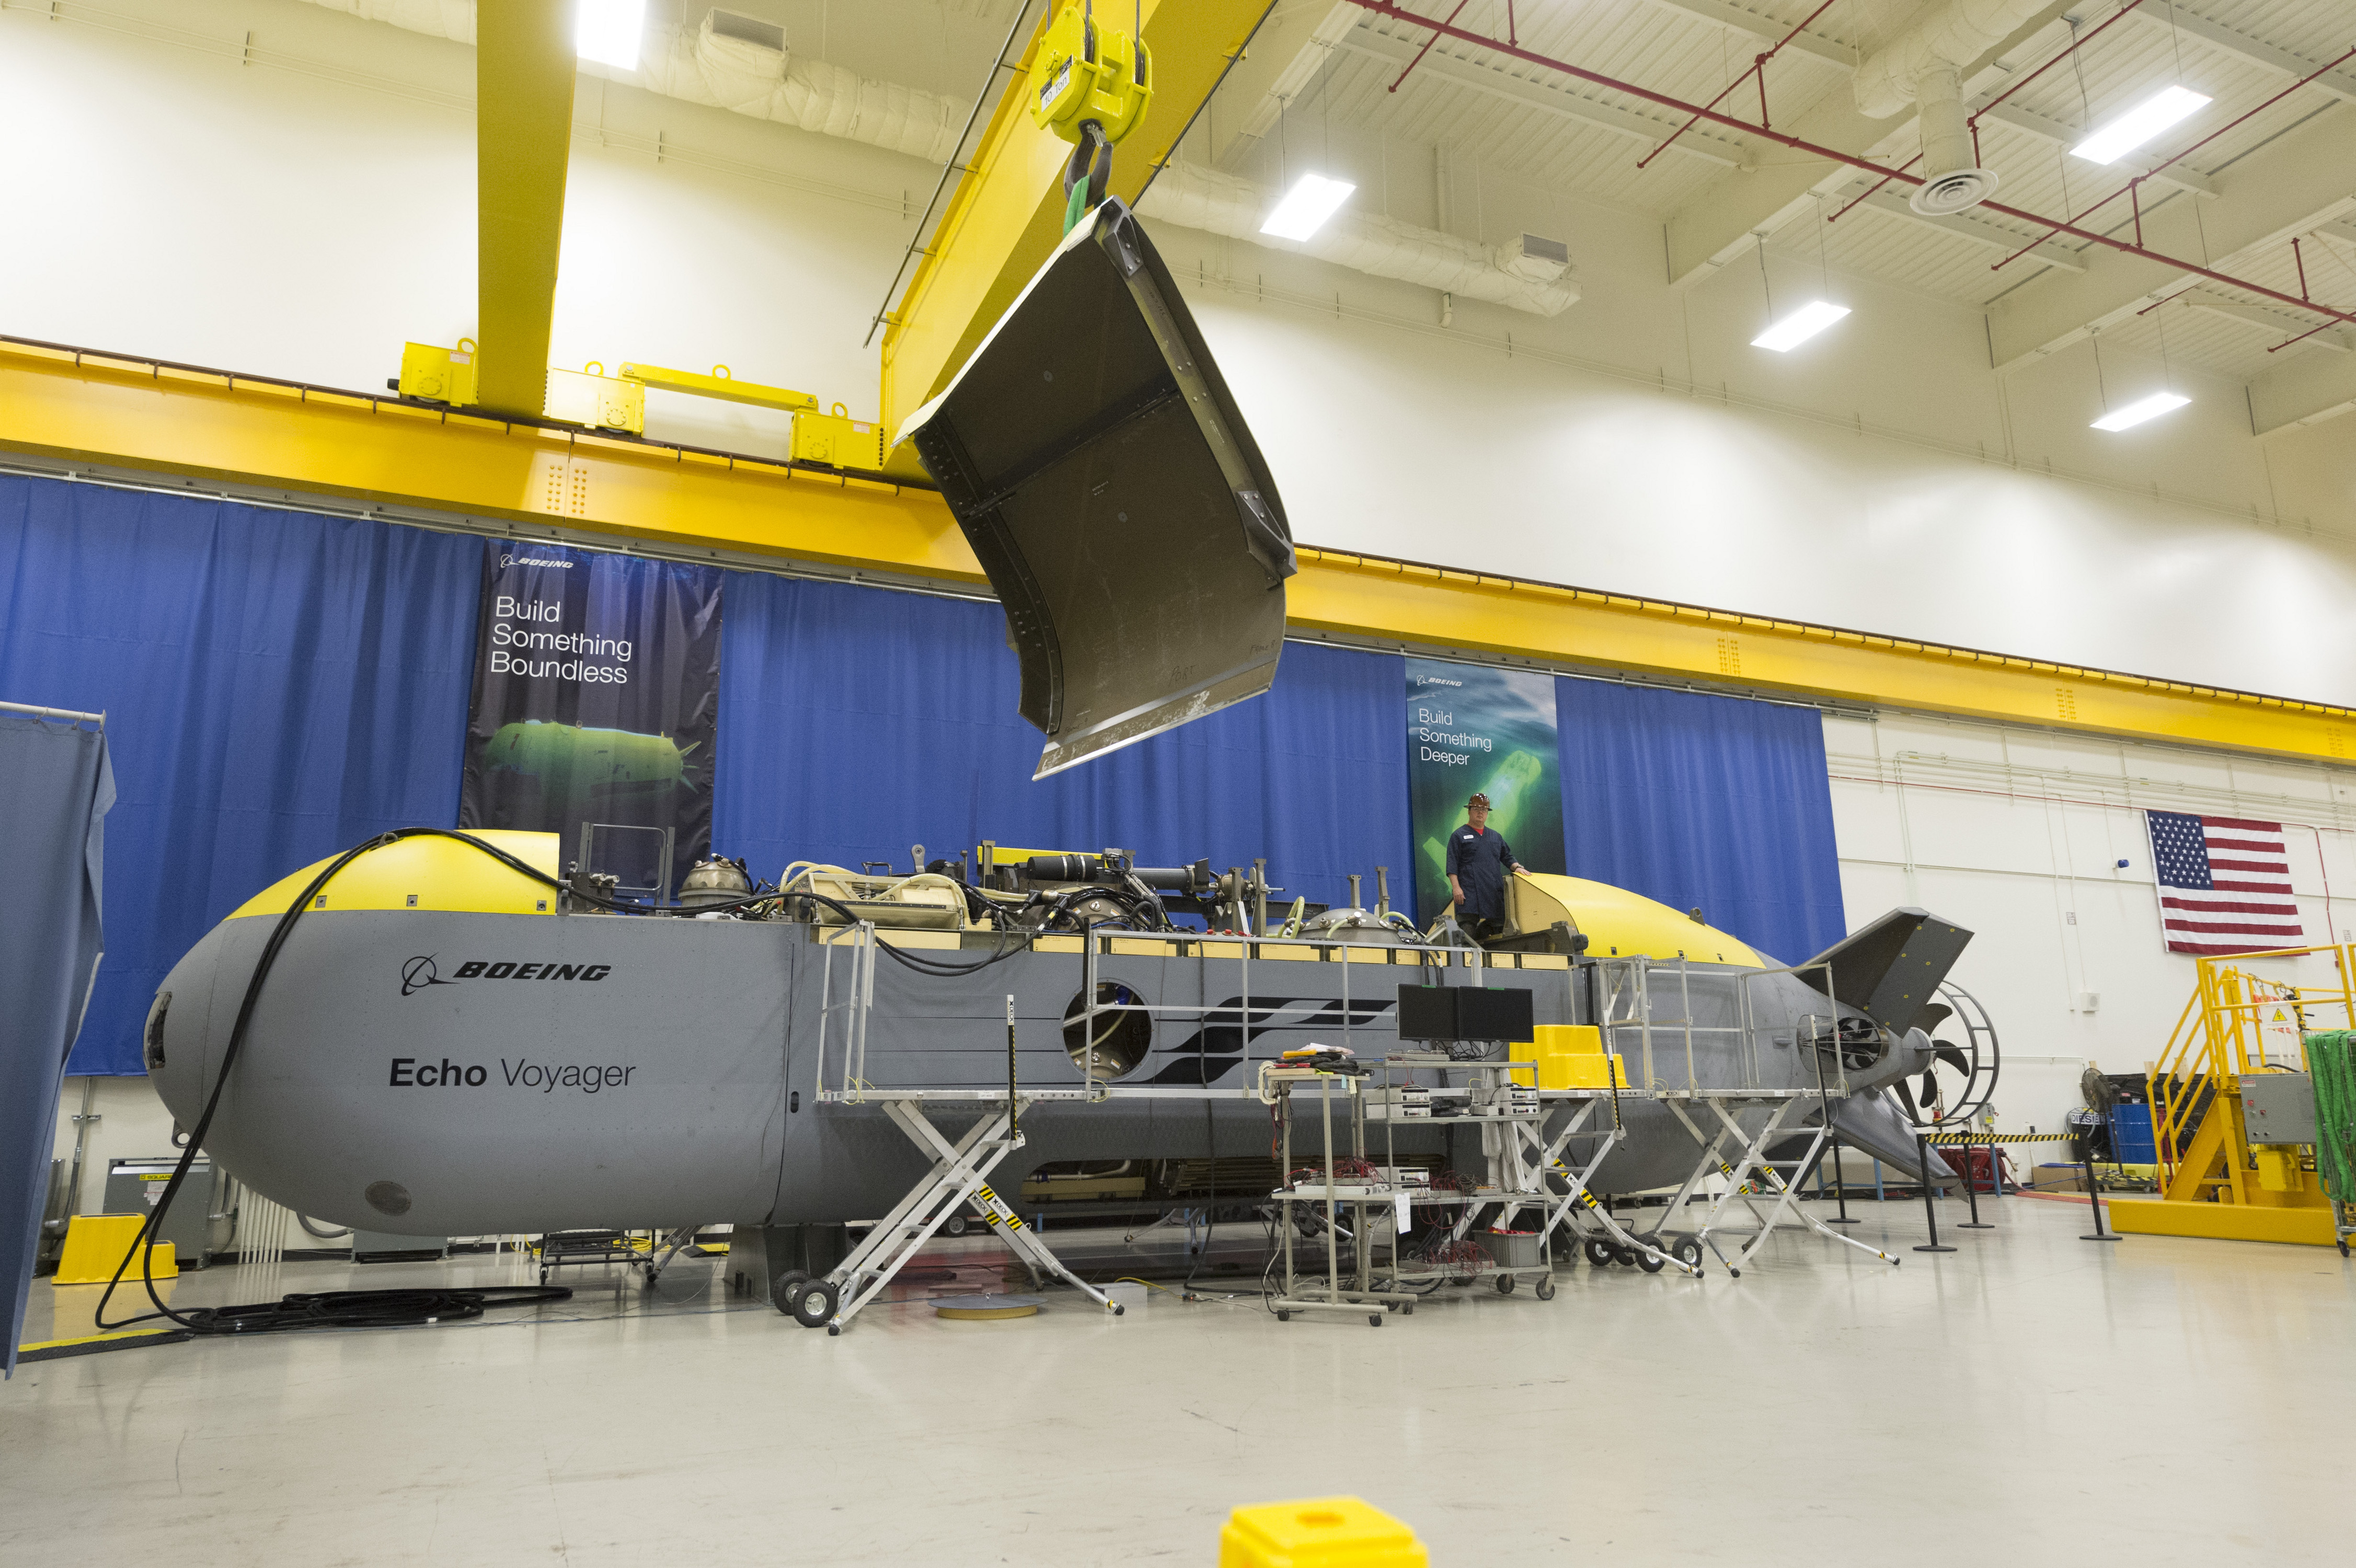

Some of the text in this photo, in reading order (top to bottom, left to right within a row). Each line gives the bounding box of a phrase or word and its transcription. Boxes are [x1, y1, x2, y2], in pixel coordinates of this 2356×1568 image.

[1045, 91, 1052, 105] 10
[1055, 77, 1067, 94] Ton
[518, 557, 573, 569] BOEING
[496, 596, 560, 622] Build
[492, 623, 632, 662] Something
[491, 651, 627, 684] Boundless
[1428, 677, 1462, 687] BOEING
[1419, 708, 1452, 725] Build
[1419, 728, 1491, 752] Something
[1420, 746, 1469, 766] Deeper
[453, 961, 612, 981] BOEING
[389, 1058, 636, 1093] Echo Voyager
[2072, 1114, 2104, 1123] DIESEL
